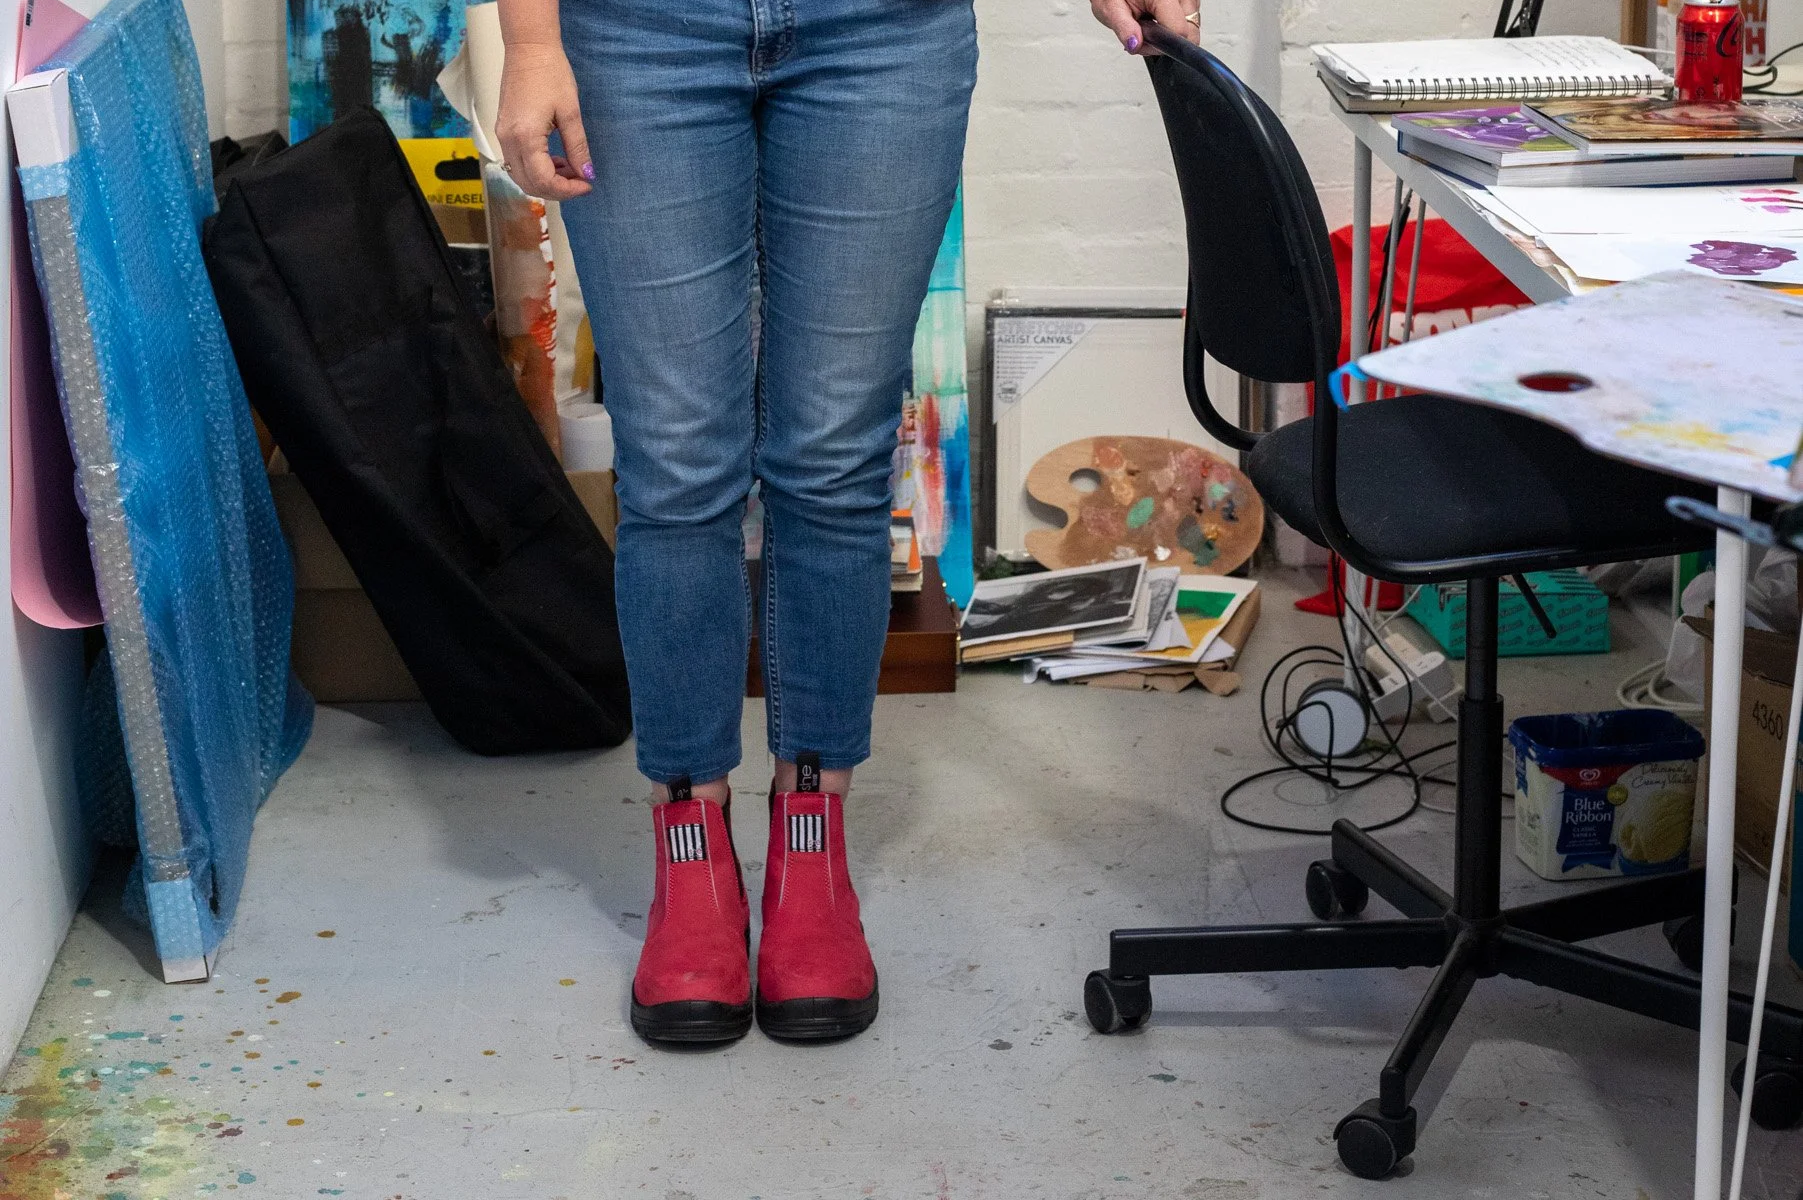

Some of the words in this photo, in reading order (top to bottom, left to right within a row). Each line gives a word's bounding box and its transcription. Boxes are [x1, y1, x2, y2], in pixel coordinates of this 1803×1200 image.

[997, 335, 1030, 344] ARTIST
[1034, 335, 1073, 344] CANVAS
[1752, 700, 1784, 740] 4360
[1574, 798, 1605, 811] Blue
[1565, 811, 1612, 825] Ribbon
